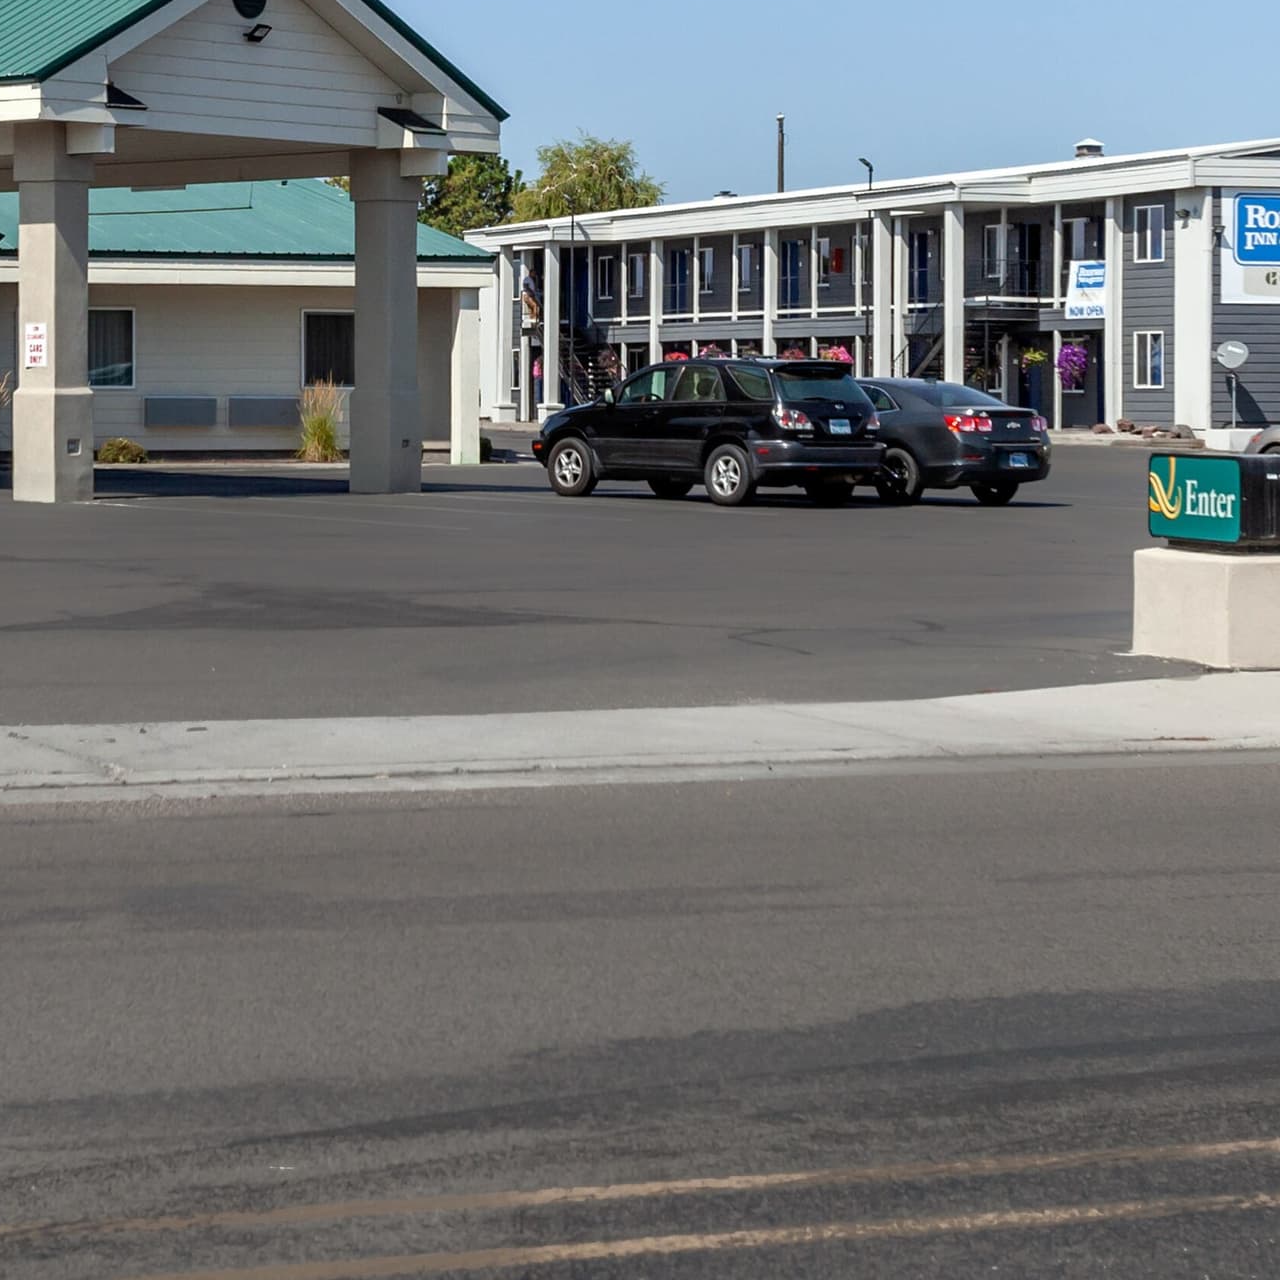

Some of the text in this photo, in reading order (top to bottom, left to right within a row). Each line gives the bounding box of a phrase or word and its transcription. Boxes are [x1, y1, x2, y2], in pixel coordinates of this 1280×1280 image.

[1244, 232, 1278, 250] INN
[1070, 305, 1104, 316] NOW OPEN
[1185, 480, 1235, 518] Enter
